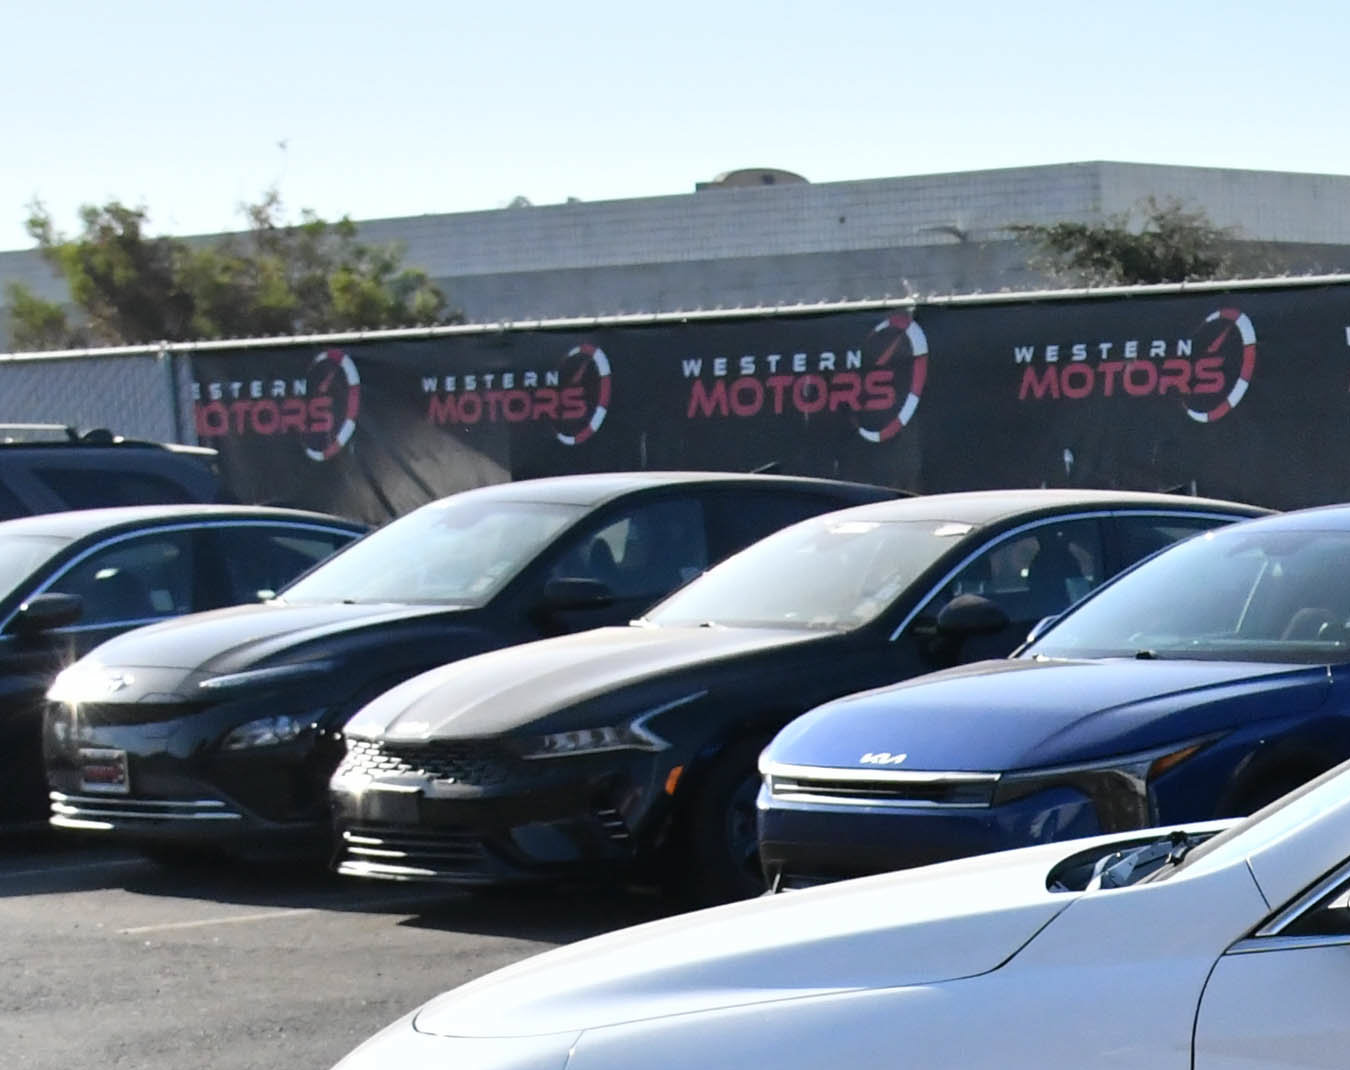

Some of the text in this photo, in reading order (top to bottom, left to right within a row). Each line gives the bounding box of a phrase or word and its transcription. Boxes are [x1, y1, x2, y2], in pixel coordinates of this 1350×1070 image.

[682, 350, 862, 377] WESTERN
[1014, 339, 1192, 363] WESTERN
[422, 371, 560, 393] WESTERN
[687, 369, 896, 418] MOTORS
[1018, 356, 1225, 399] MOTORS
[195, 396, 334, 436] OTORS
[427, 386, 588, 424] MOTORS
